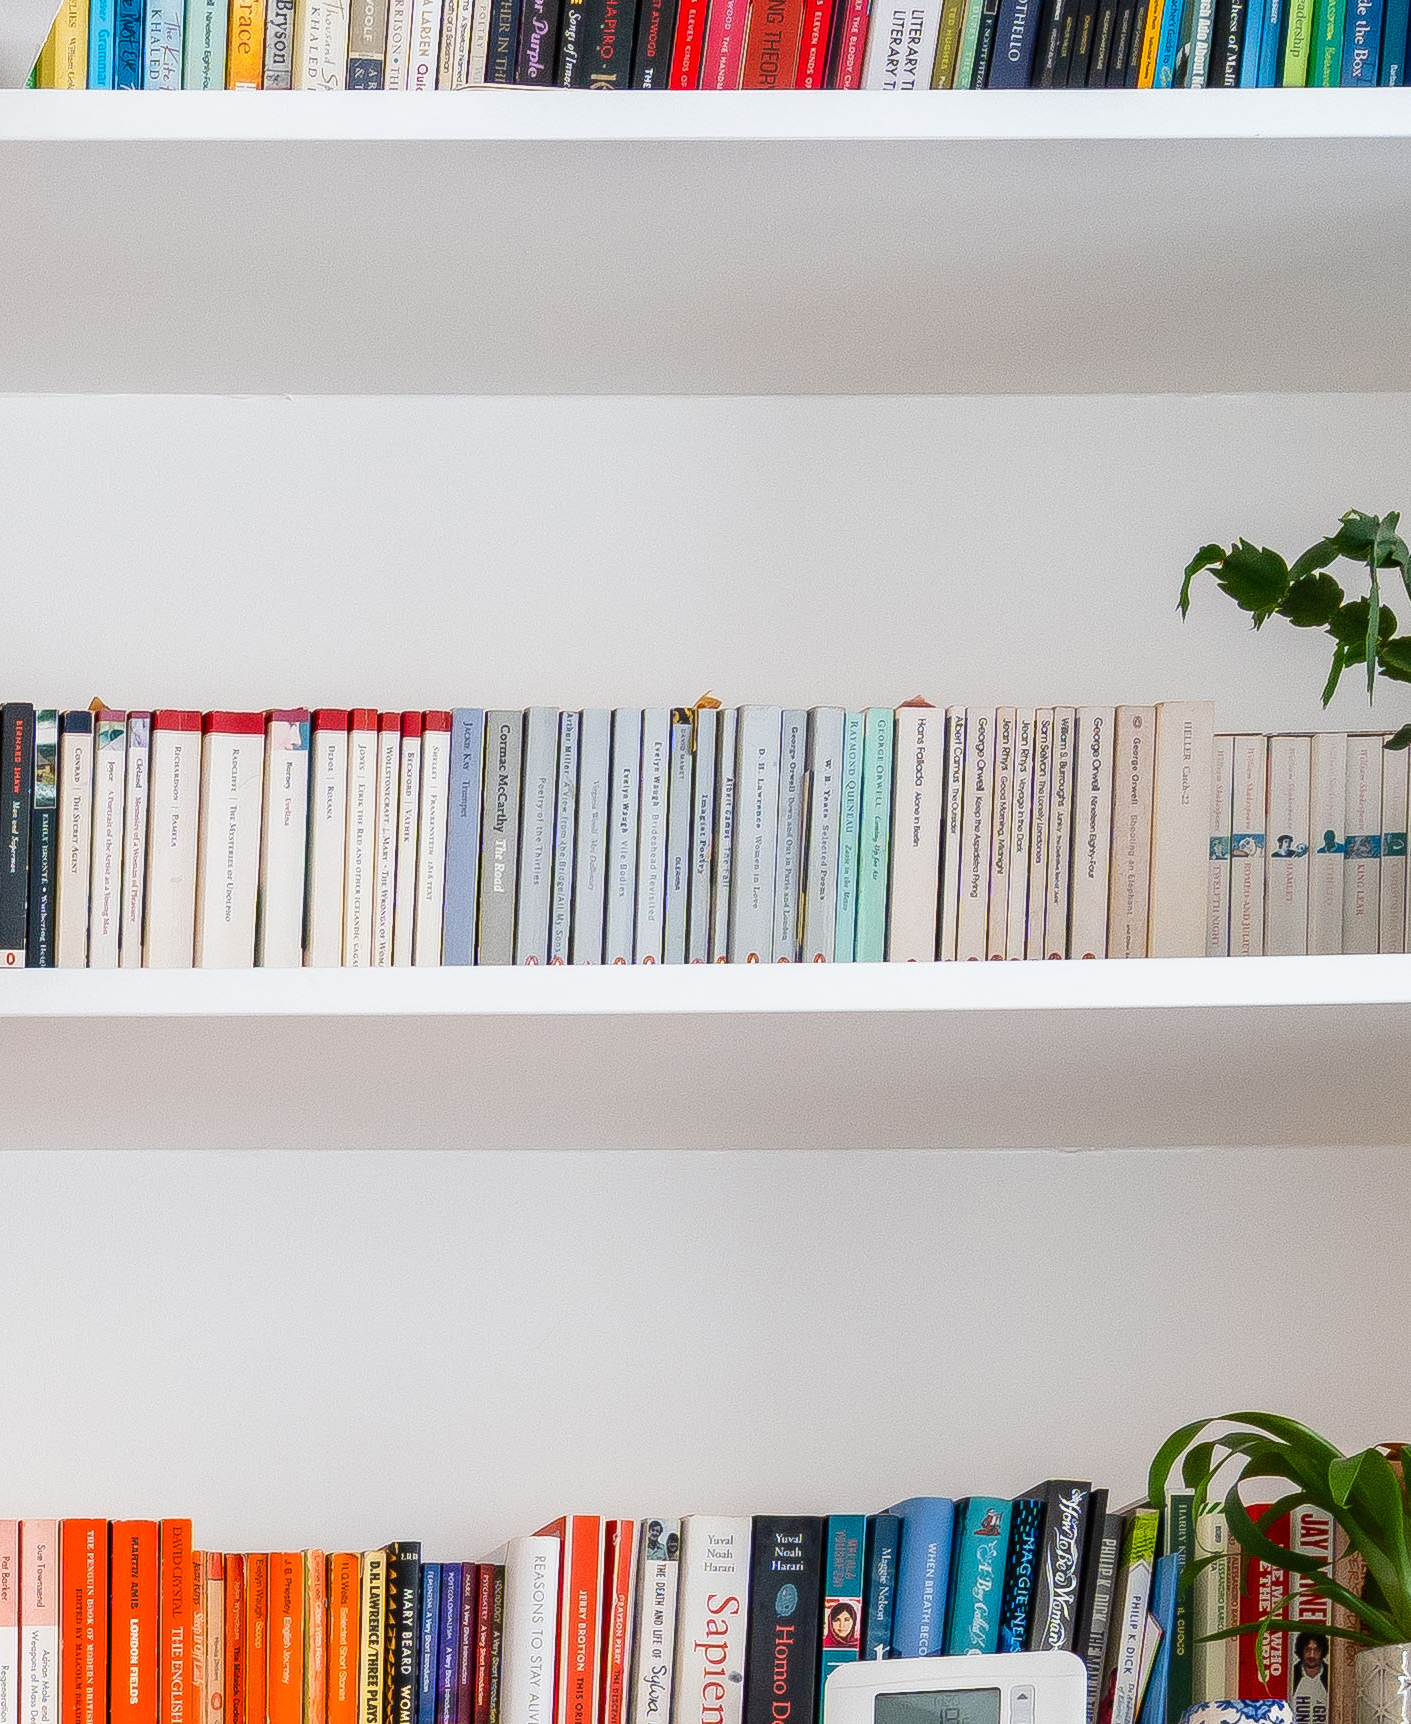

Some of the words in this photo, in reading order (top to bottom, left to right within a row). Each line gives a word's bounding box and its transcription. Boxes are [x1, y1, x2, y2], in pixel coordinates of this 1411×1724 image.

[149, 10, 161, 80] KHALED
[528, 19, 547, 78] Purple
[1355, 20, 1372, 45] the
[1352, 49, 1370, 77] Box
[497, 725, 510, 771] Cormac
[494, 774, 508, 832] McCarthy
[495, 839, 506, 861] The
[493, 863, 505, 892] Road
[774, 1547, 802, 1557] Noah
[775, 1533, 803, 1544] Yuval
[771, 1561, 804, 1571] Harari
[401, 1589, 413, 1628] MARY
[130, 1619, 138, 1664] LONDON
[172, 1627, 183, 1658] THE
[400, 1632, 412, 1674] BEARD
[773, 1625, 795, 1695] Homo
[130, 1667, 138, 1704] FIELDS
[171, 1661, 182, 1723] ENGLISH
